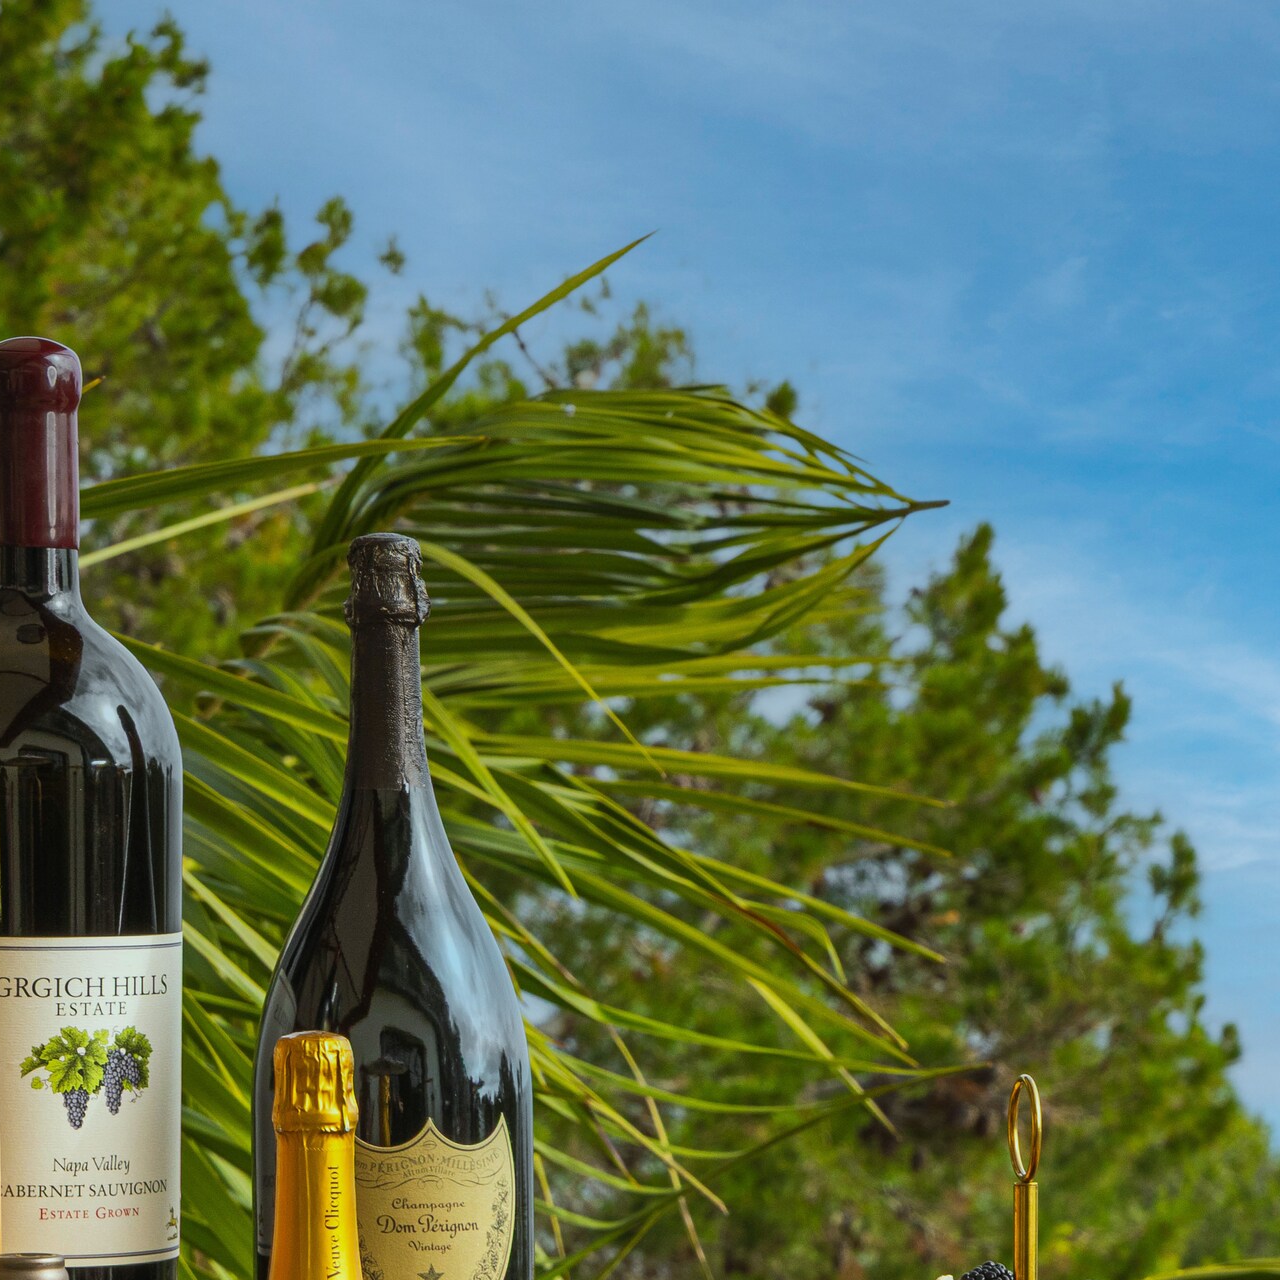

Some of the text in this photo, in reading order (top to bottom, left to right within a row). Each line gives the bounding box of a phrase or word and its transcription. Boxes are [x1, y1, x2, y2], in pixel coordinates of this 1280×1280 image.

[113, 973, 168, 997] HILLS
[56, 1001, 128, 1017] ESTATE
[53, 1155, 131, 1178] Napa Valley
[0, 1179, 168, 1198] ABERNET SAUVIGNON
[392, 1197, 467, 1212] Champagne
[324, 1166, 342, 1280] Veuve Clicquot
[377, 1213, 479, 1239] Dom Pérignon
[408, 1240, 453, 1254] Vintage
